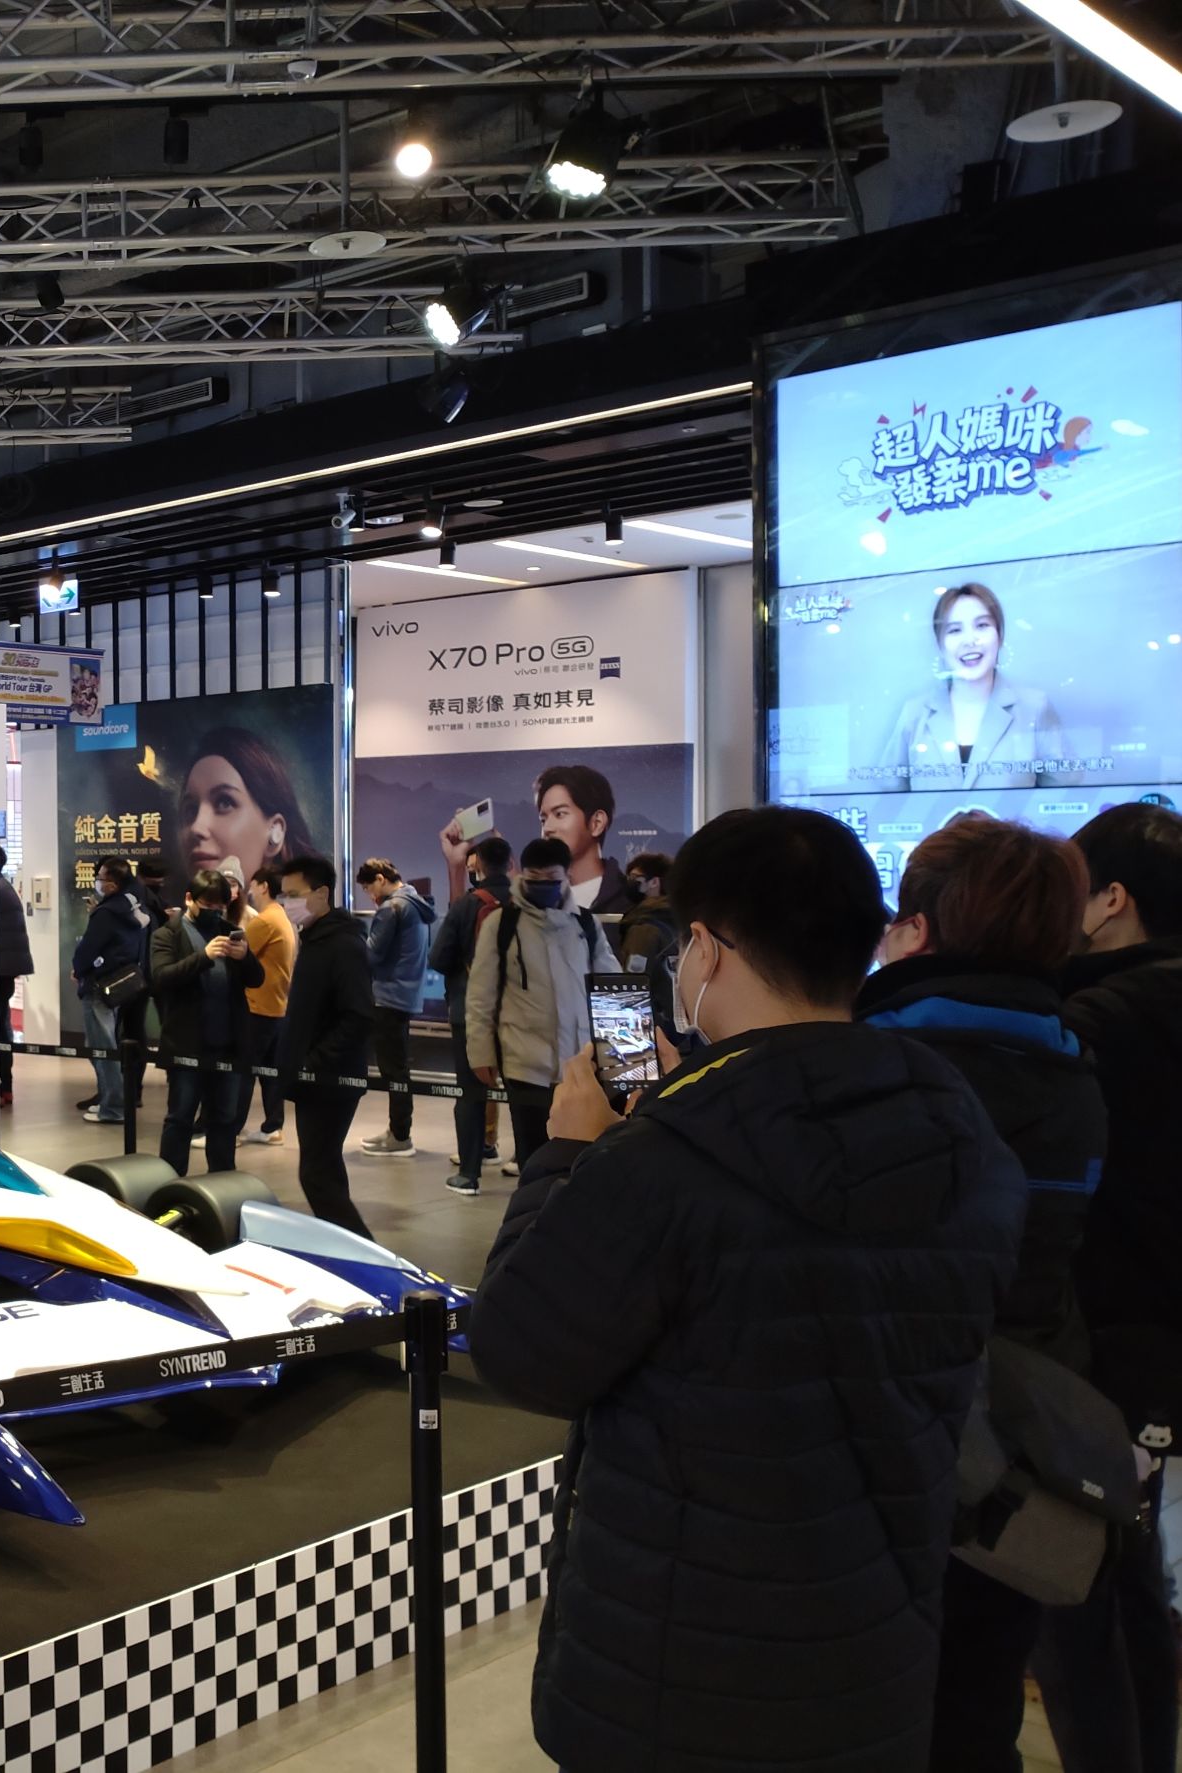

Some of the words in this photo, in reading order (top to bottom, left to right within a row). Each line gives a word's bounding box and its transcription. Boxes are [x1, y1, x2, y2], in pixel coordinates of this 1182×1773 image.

[873, 401, 1059, 474] 超人媽咪
[371, 620, 419, 637] vivo
[428, 645, 487, 671] X70
[495, 642, 545, 666] Pro
[557, 640, 587, 655] 5G
[514, 668, 538, 676] vivo
[13, 683, 28, 692] Tour
[428, 695, 505, 716] 蔡司影像
[513, 688, 596, 712] 真如其見
[82, 720, 129, 737] soundcore
[74, 812, 162, 844] 純金音質
[338, 1076, 368, 1088] SYNTREND
[431, 1085, 464, 1097] SYNTREND
[275, 1335, 316, 1358] 三創生活
[159, 1350, 227, 1378] SYNTREND
[59, 1370, 105, 1397] 三創生活
